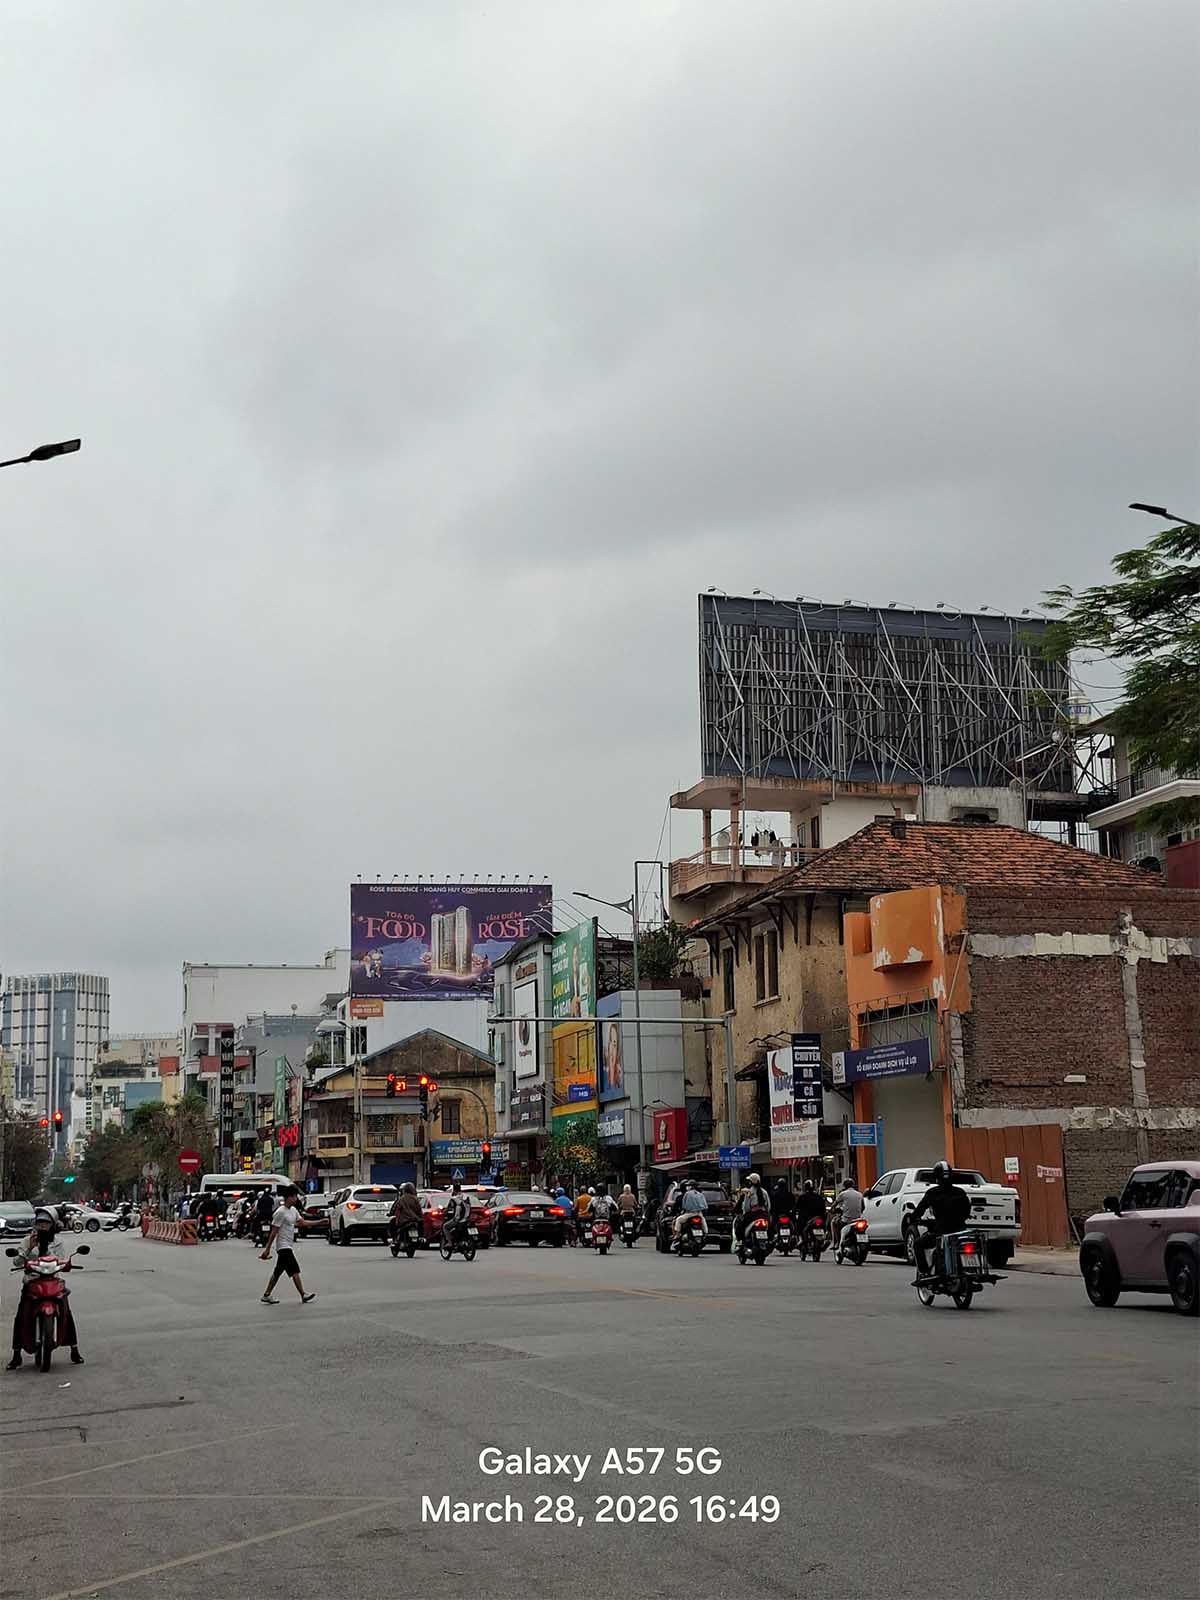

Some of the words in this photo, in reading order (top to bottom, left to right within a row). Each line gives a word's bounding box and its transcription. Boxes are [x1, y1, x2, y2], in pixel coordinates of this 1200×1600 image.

[365, 916, 426, 939] FOOD
[478, 919, 530, 939] ROSE
[396, 1081, 406, 1090] 27
